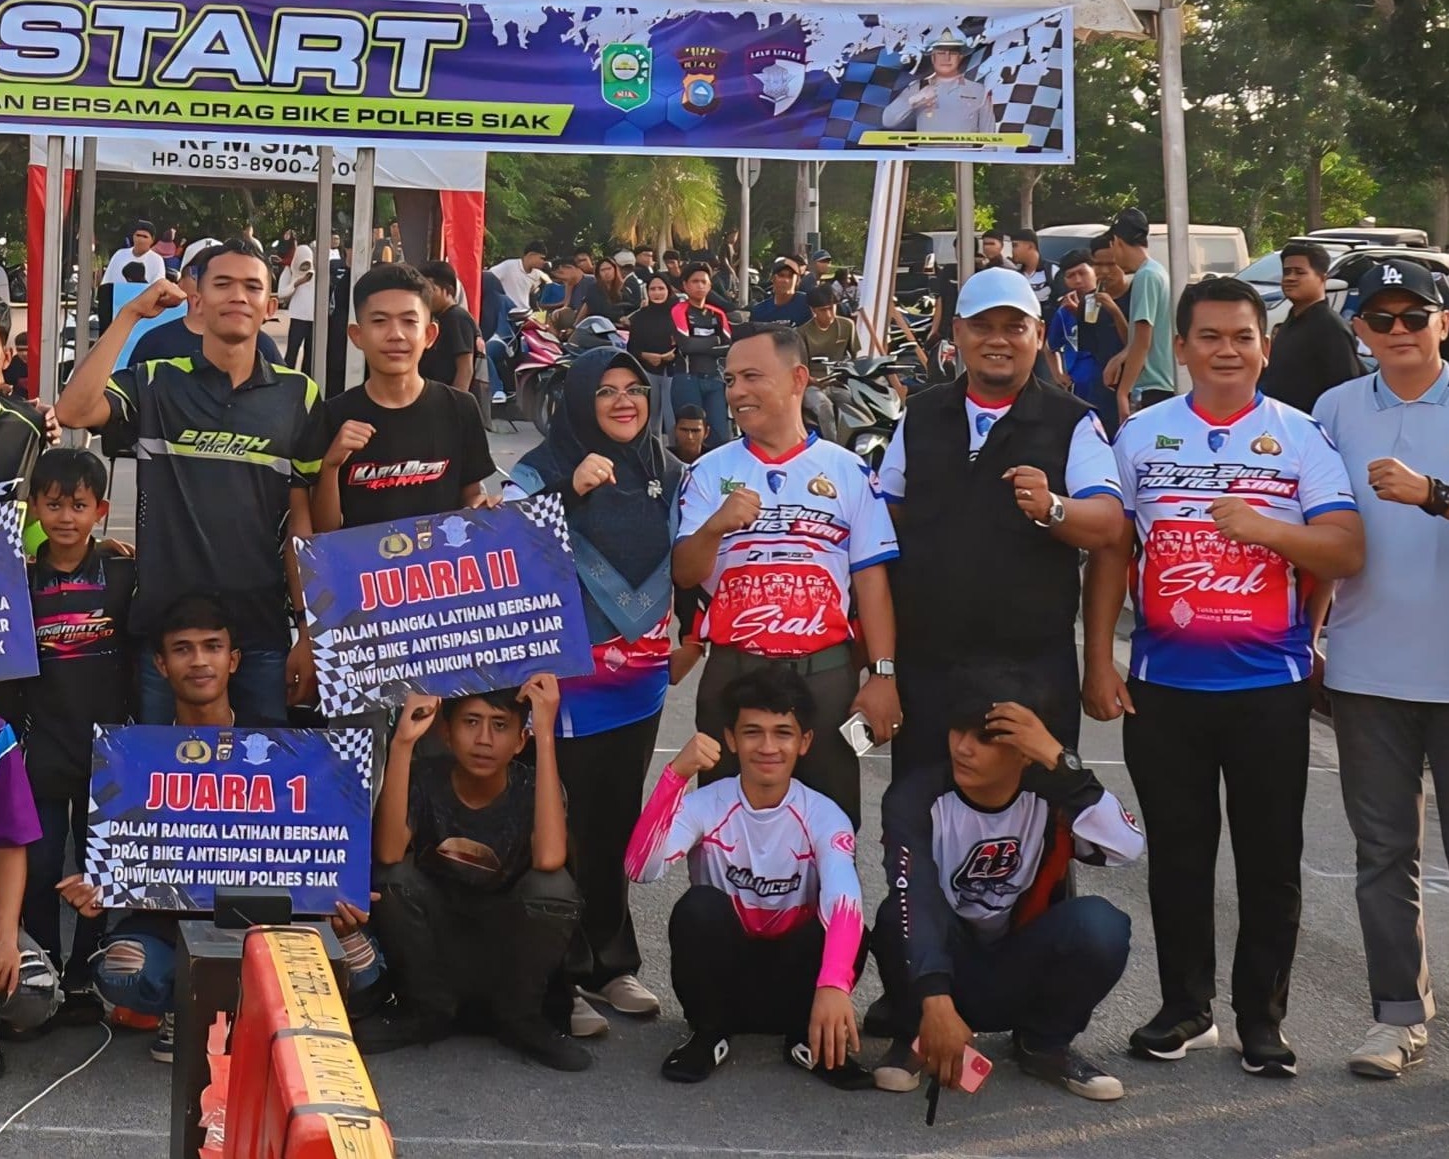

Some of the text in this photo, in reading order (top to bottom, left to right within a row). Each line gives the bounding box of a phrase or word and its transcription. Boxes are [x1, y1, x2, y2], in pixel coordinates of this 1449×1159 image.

[32, 96, 183, 116] BERSAMA
[190, 102, 274, 120] DRAG
[282, 105, 350, 123] BIKE
[358, 109, 473, 127] POLRES
[482, 113, 551, 130] SIAK
[152, 151, 182, 168] HP.
[1382, 264, 1403, 285] LA
[360, 549, 520, 611] JUARA II
[1158, 562, 1267, 596] Siak
[332, 593, 562, 643] DALAM RANGKA LATIHAN BERSAMA
[730, 604, 828, 641] Siak
[338, 616, 563, 666] DRAG BIKE ANTISIPASI BALAP LIAR
[426, 653, 472, 674] HUKUM
[476, 646, 526, 667] POLRES
[530, 640, 561, 657] SIAK
[146, 772, 307, 813] JUARA 1
[110, 821, 349, 841] DALAM RANGKA LATIHAN BERSAMA
[111, 843, 346, 864] DRAG BIKE ANTISIPASI BALAP LIAR
[197, 870, 246, 886] HUKUM
[250, 870, 302, 886] POLRES
[306, 871, 338, 887] SIAK
